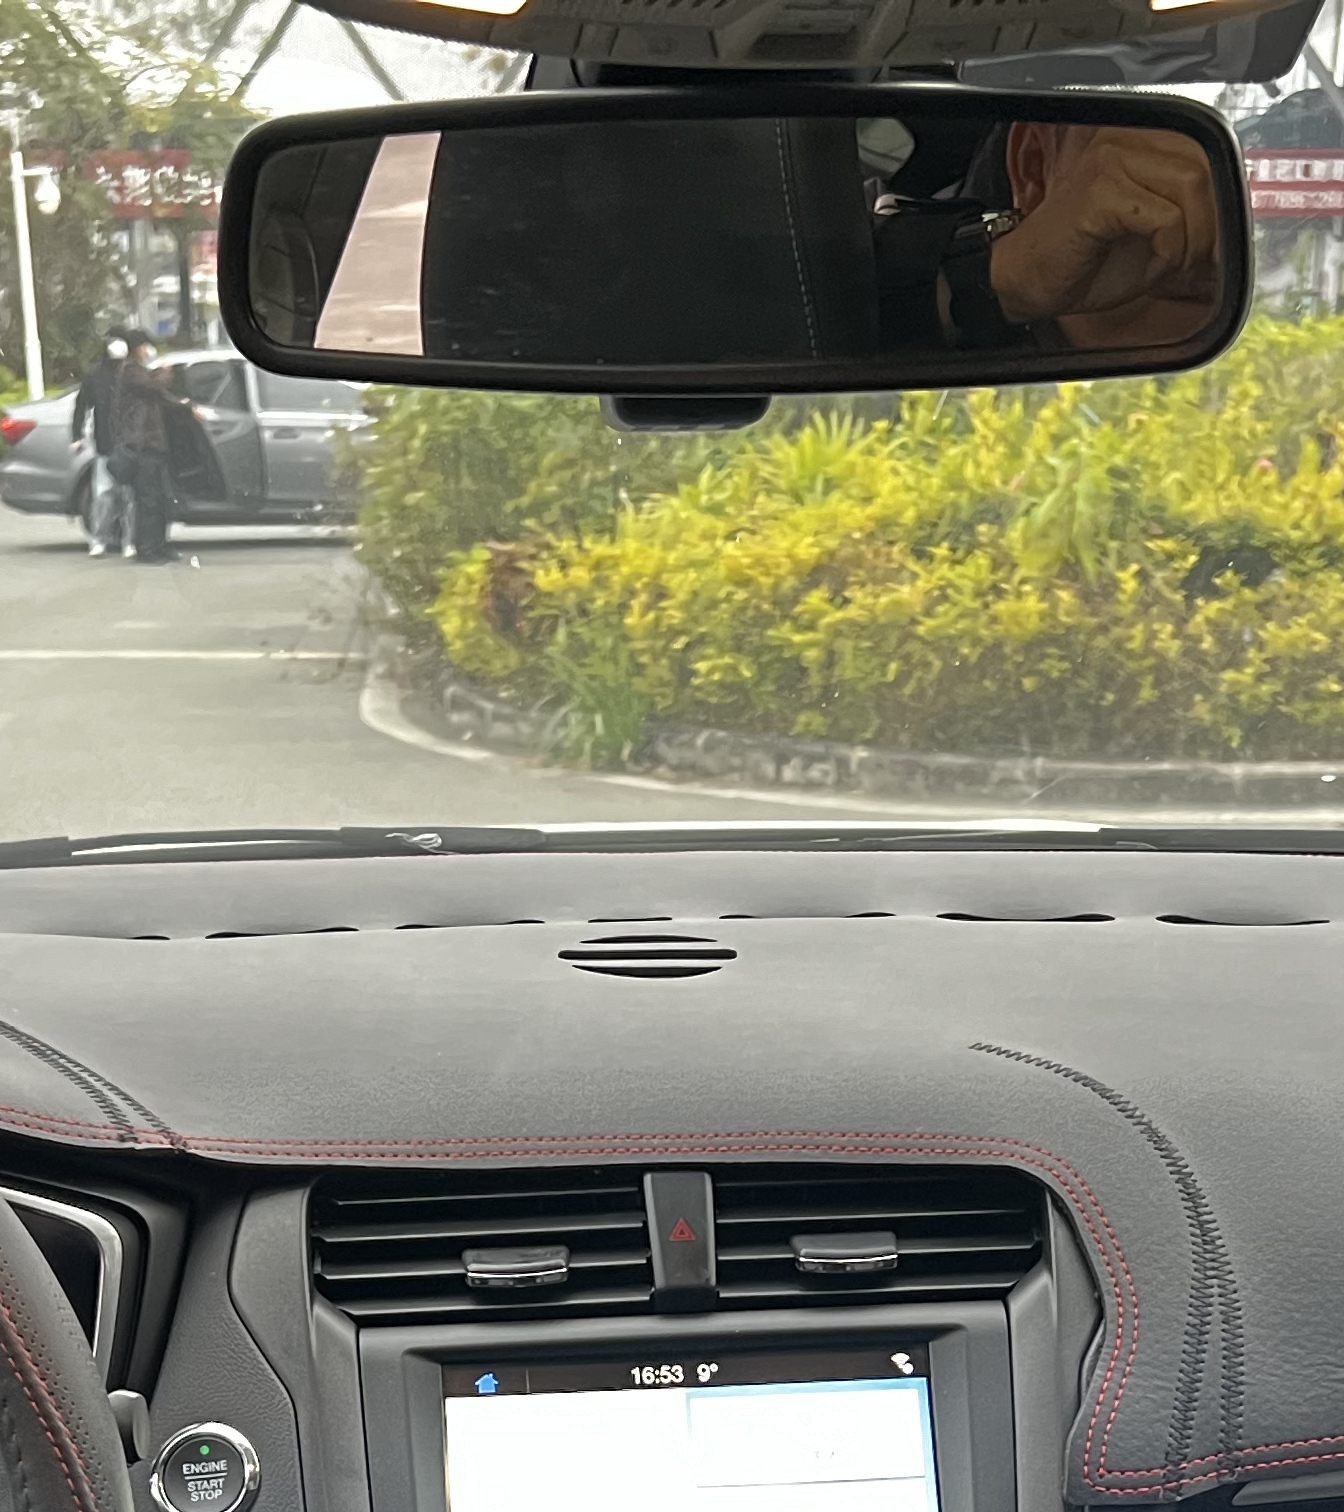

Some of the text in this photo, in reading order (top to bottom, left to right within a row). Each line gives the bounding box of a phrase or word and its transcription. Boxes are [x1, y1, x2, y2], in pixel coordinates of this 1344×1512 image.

[630, 1363, 718, 1384] 16:53 9°
[182, 1460, 228, 1475] ENGINE
[187, 1478, 225, 1492] START
[190, 1489, 223, 1502] STOP
